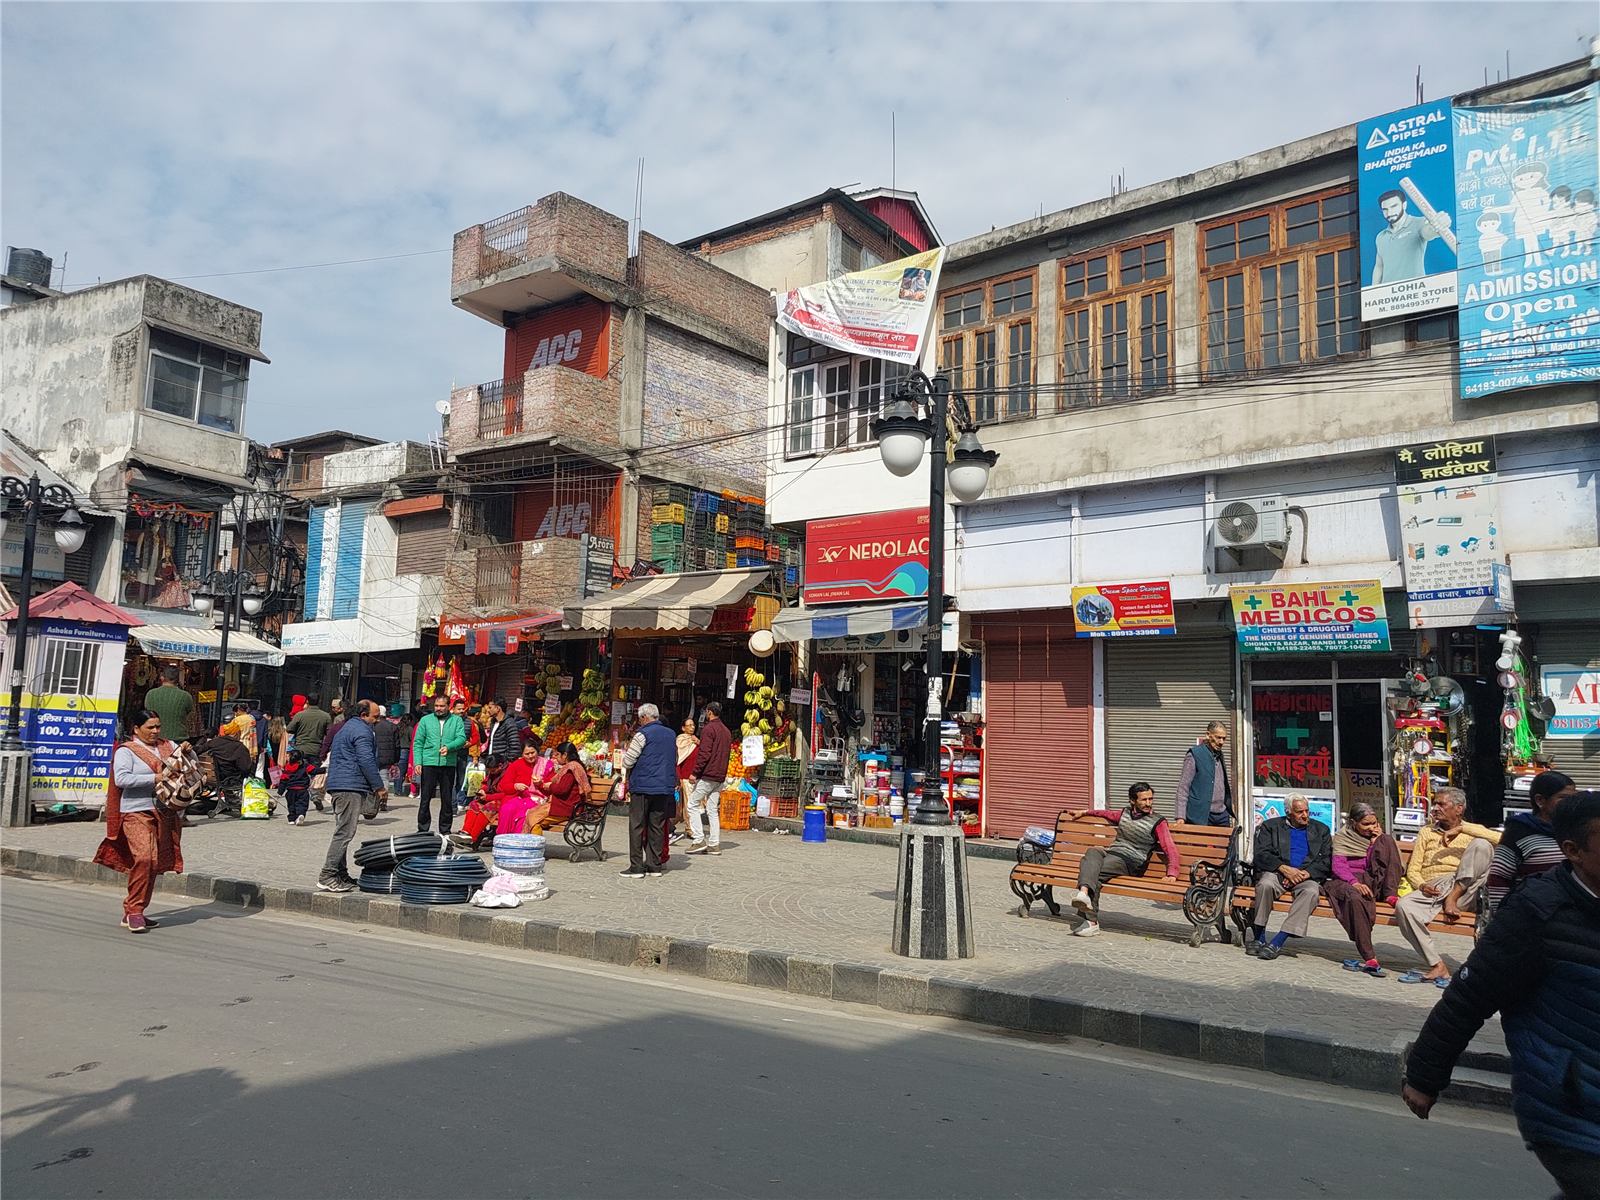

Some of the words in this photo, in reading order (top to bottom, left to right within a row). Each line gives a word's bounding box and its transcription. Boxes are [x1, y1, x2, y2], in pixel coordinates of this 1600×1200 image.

[1387, 109, 1446, 135] ASTRAL
[1392, 127, 1426, 142] PIPES
[1511, 127, 1525, 141] &
[1364, 144, 1447, 171] BHAROSEMAND
[1384, 144, 1411, 158] INDIA
[1412, 141, 1426, 151] KA
[1466, 144, 1517, 170] Pvt.
[1390, 161, 1412, 173] PIPE
[1391, 281, 1426, 294] LOHIA
[1464, 260, 1598, 303] ADMISSION
[1364, 293, 1419, 308] HARDWARE
[1422, 286, 1455, 298] STORE
[1484, 293, 1577, 321] Open
[528, 329, 583, 370] ACC
[1422, 441, 1484, 461] लोहिया
[1420, 459, 1490, 480] हार्डवेयर
[534, 502, 592, 539] ACC
[588, 536, 614, 549] Arora
[1270, 590, 1335, 608] BAHL
[1240, 606, 1377, 626] MEDICOS
[47, 626, 73, 636] Ashoka
[73, 628, 107, 639] Furniture
[1261, 626, 1297, 634] CHEMIST
[1307, 625, 1351, 633] DRUGGIST
[1299, 633, 1334, 641] GENUINE
[1335, 632, 1379, 640] MEDICINES
[1253, 693, 1331, 712] MEDICINE
[90, 748, 109, 757] 101
[74, 766, 90, 777] 102,
[32, 778, 60, 789] shoka
[61, 779, 103, 790] Furniture
